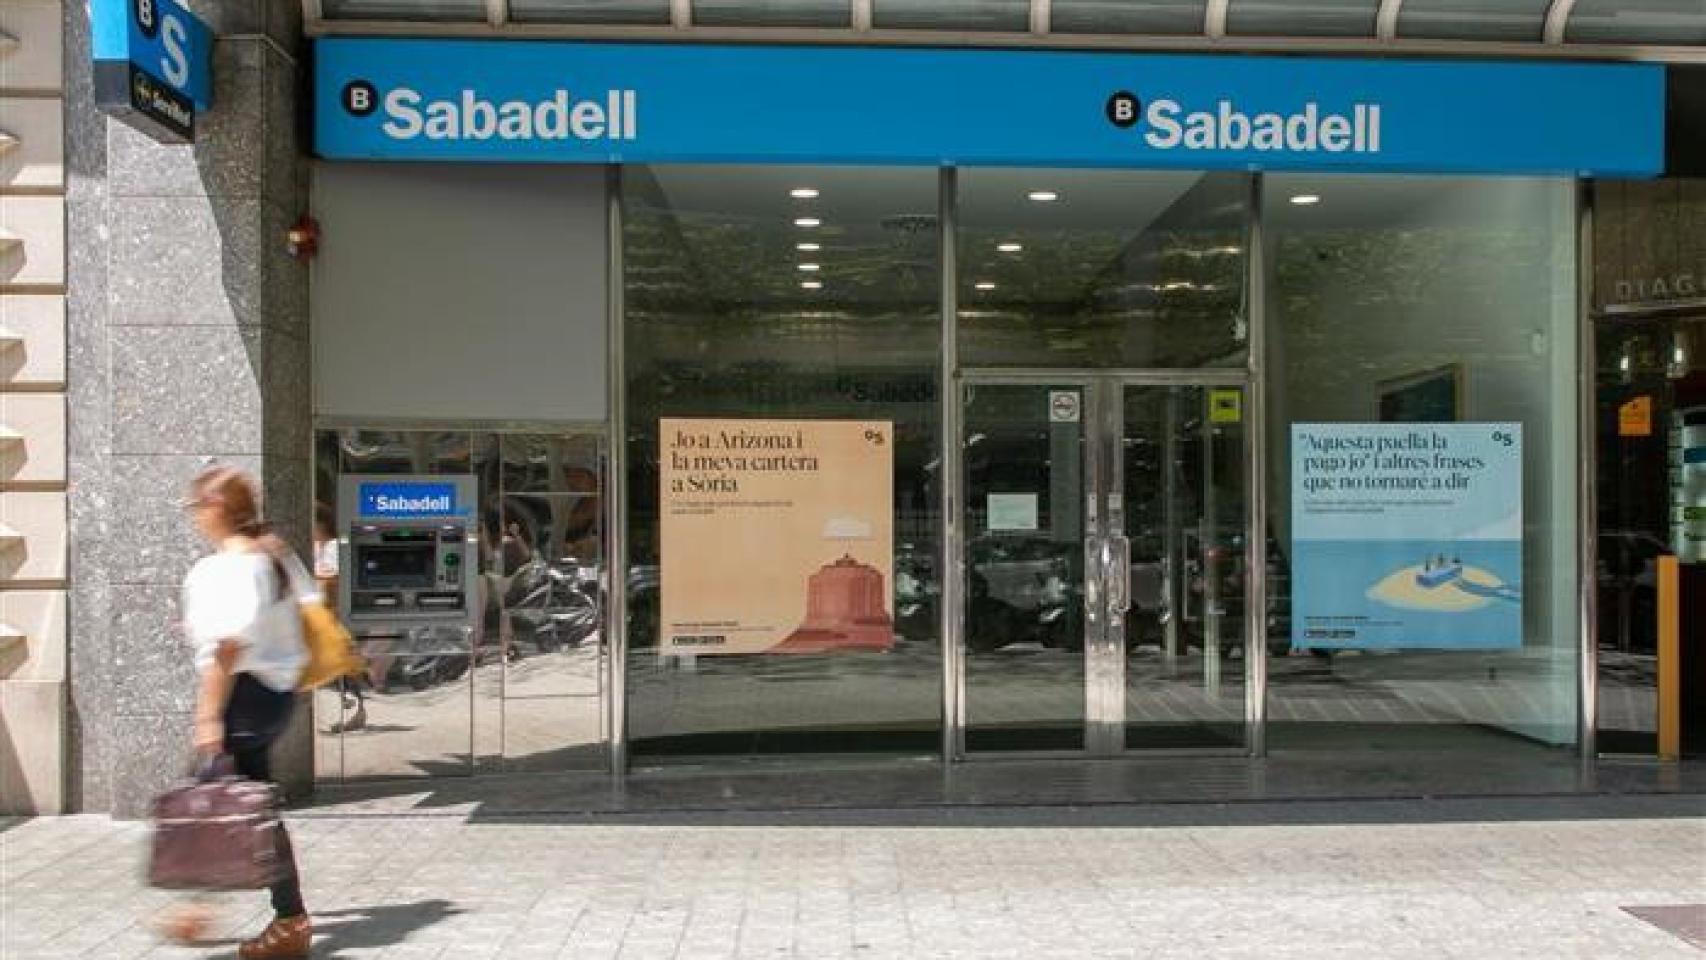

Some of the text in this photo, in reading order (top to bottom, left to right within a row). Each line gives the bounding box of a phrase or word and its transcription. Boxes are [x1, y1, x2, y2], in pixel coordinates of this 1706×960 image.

[161, 14, 189, 88] S
[351, 87, 636, 139] B Sabadell
[1115, 99, 1380, 152] B Sabadell
[671, 430, 695, 449] Jo
[699, 434, 710, 449] a
[714, 430, 793, 449] Arizona
[1376, 432, 1429, 452] paella
[1433, 432, 1448, 449] la
[672, 451, 818, 470] la meva cartera
[1304, 456, 1346, 472] pago
[1381, 453, 1430, 469] altres
[1433, 453, 1486, 469] frases
[672, 478, 684, 493] a
[1304, 477, 1336, 493] que
[1340, 477, 1362, 490] no
[1445, 472, 1470, 490] dir
[377, 495, 449, 510] Sabadell
